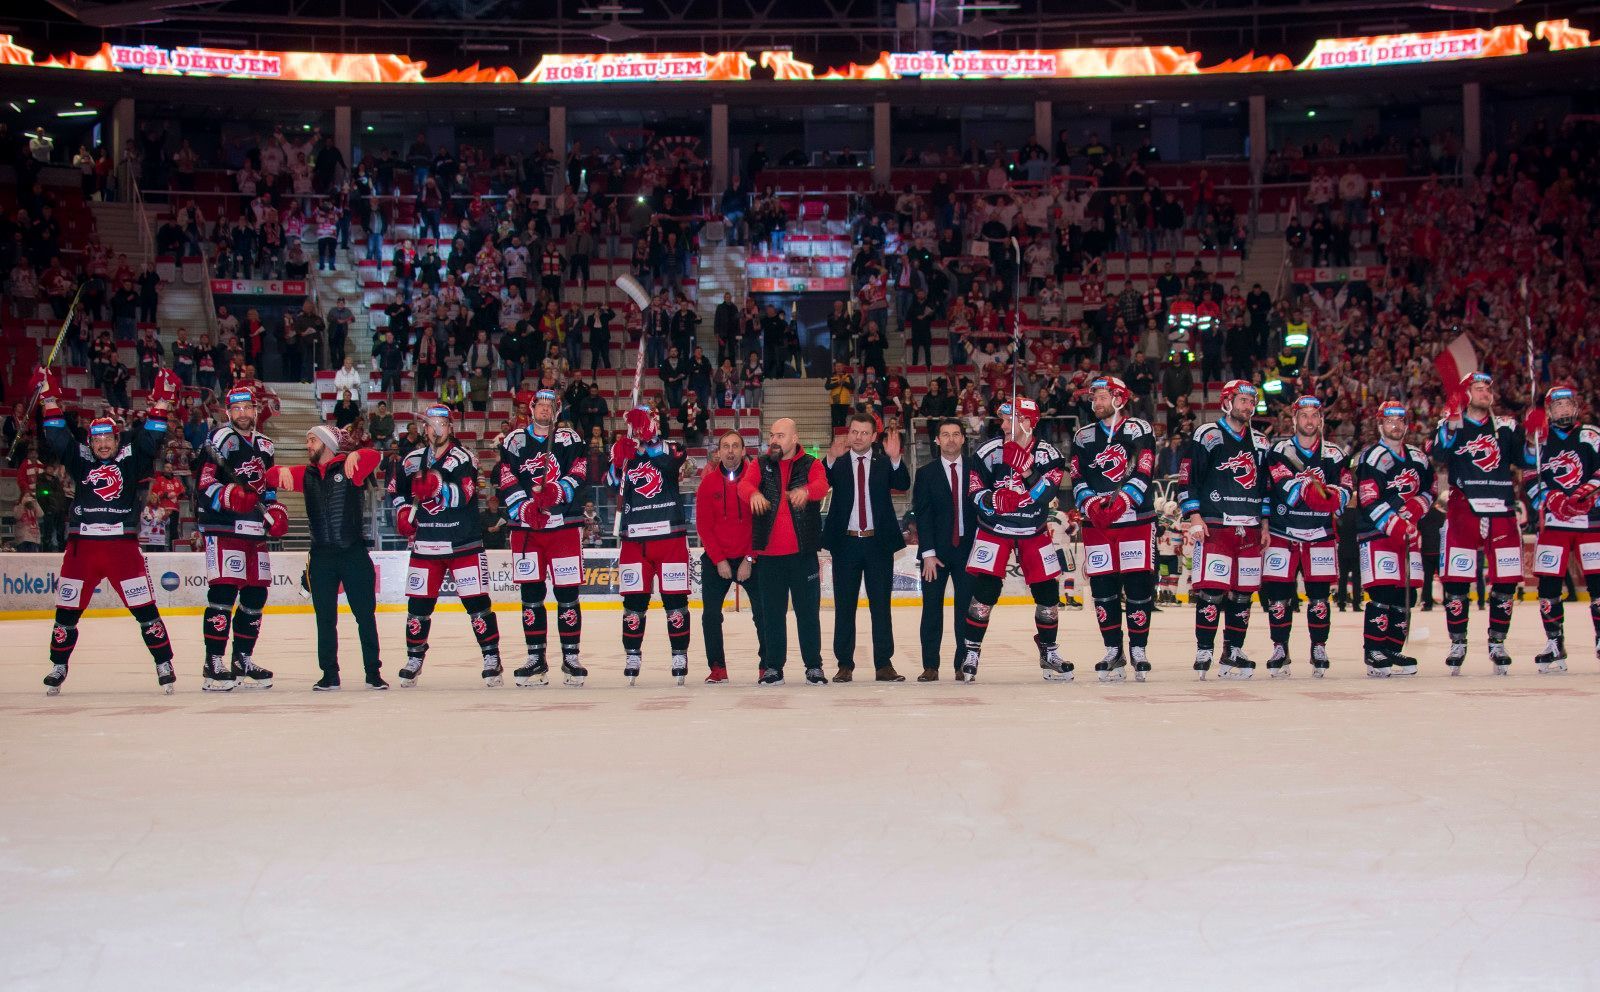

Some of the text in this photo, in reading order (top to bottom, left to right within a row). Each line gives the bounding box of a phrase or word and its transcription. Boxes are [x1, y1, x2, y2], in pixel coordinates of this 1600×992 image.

[116, 45, 279, 73] HOŠI DĚKUJEM
[894, 51, 1054, 72] HOŠI DĚKUJEM
[1319, 38, 1478, 66] HOŠI DĚKUJEM
[545, 59, 703, 80] HOŠI DĚKUJEM
[3, 572, 60, 594] hokejk
[124, 585, 147, 595] KOMA
[273, 574, 293, 585] LTA
[493, 582, 521, 592] Luhac
